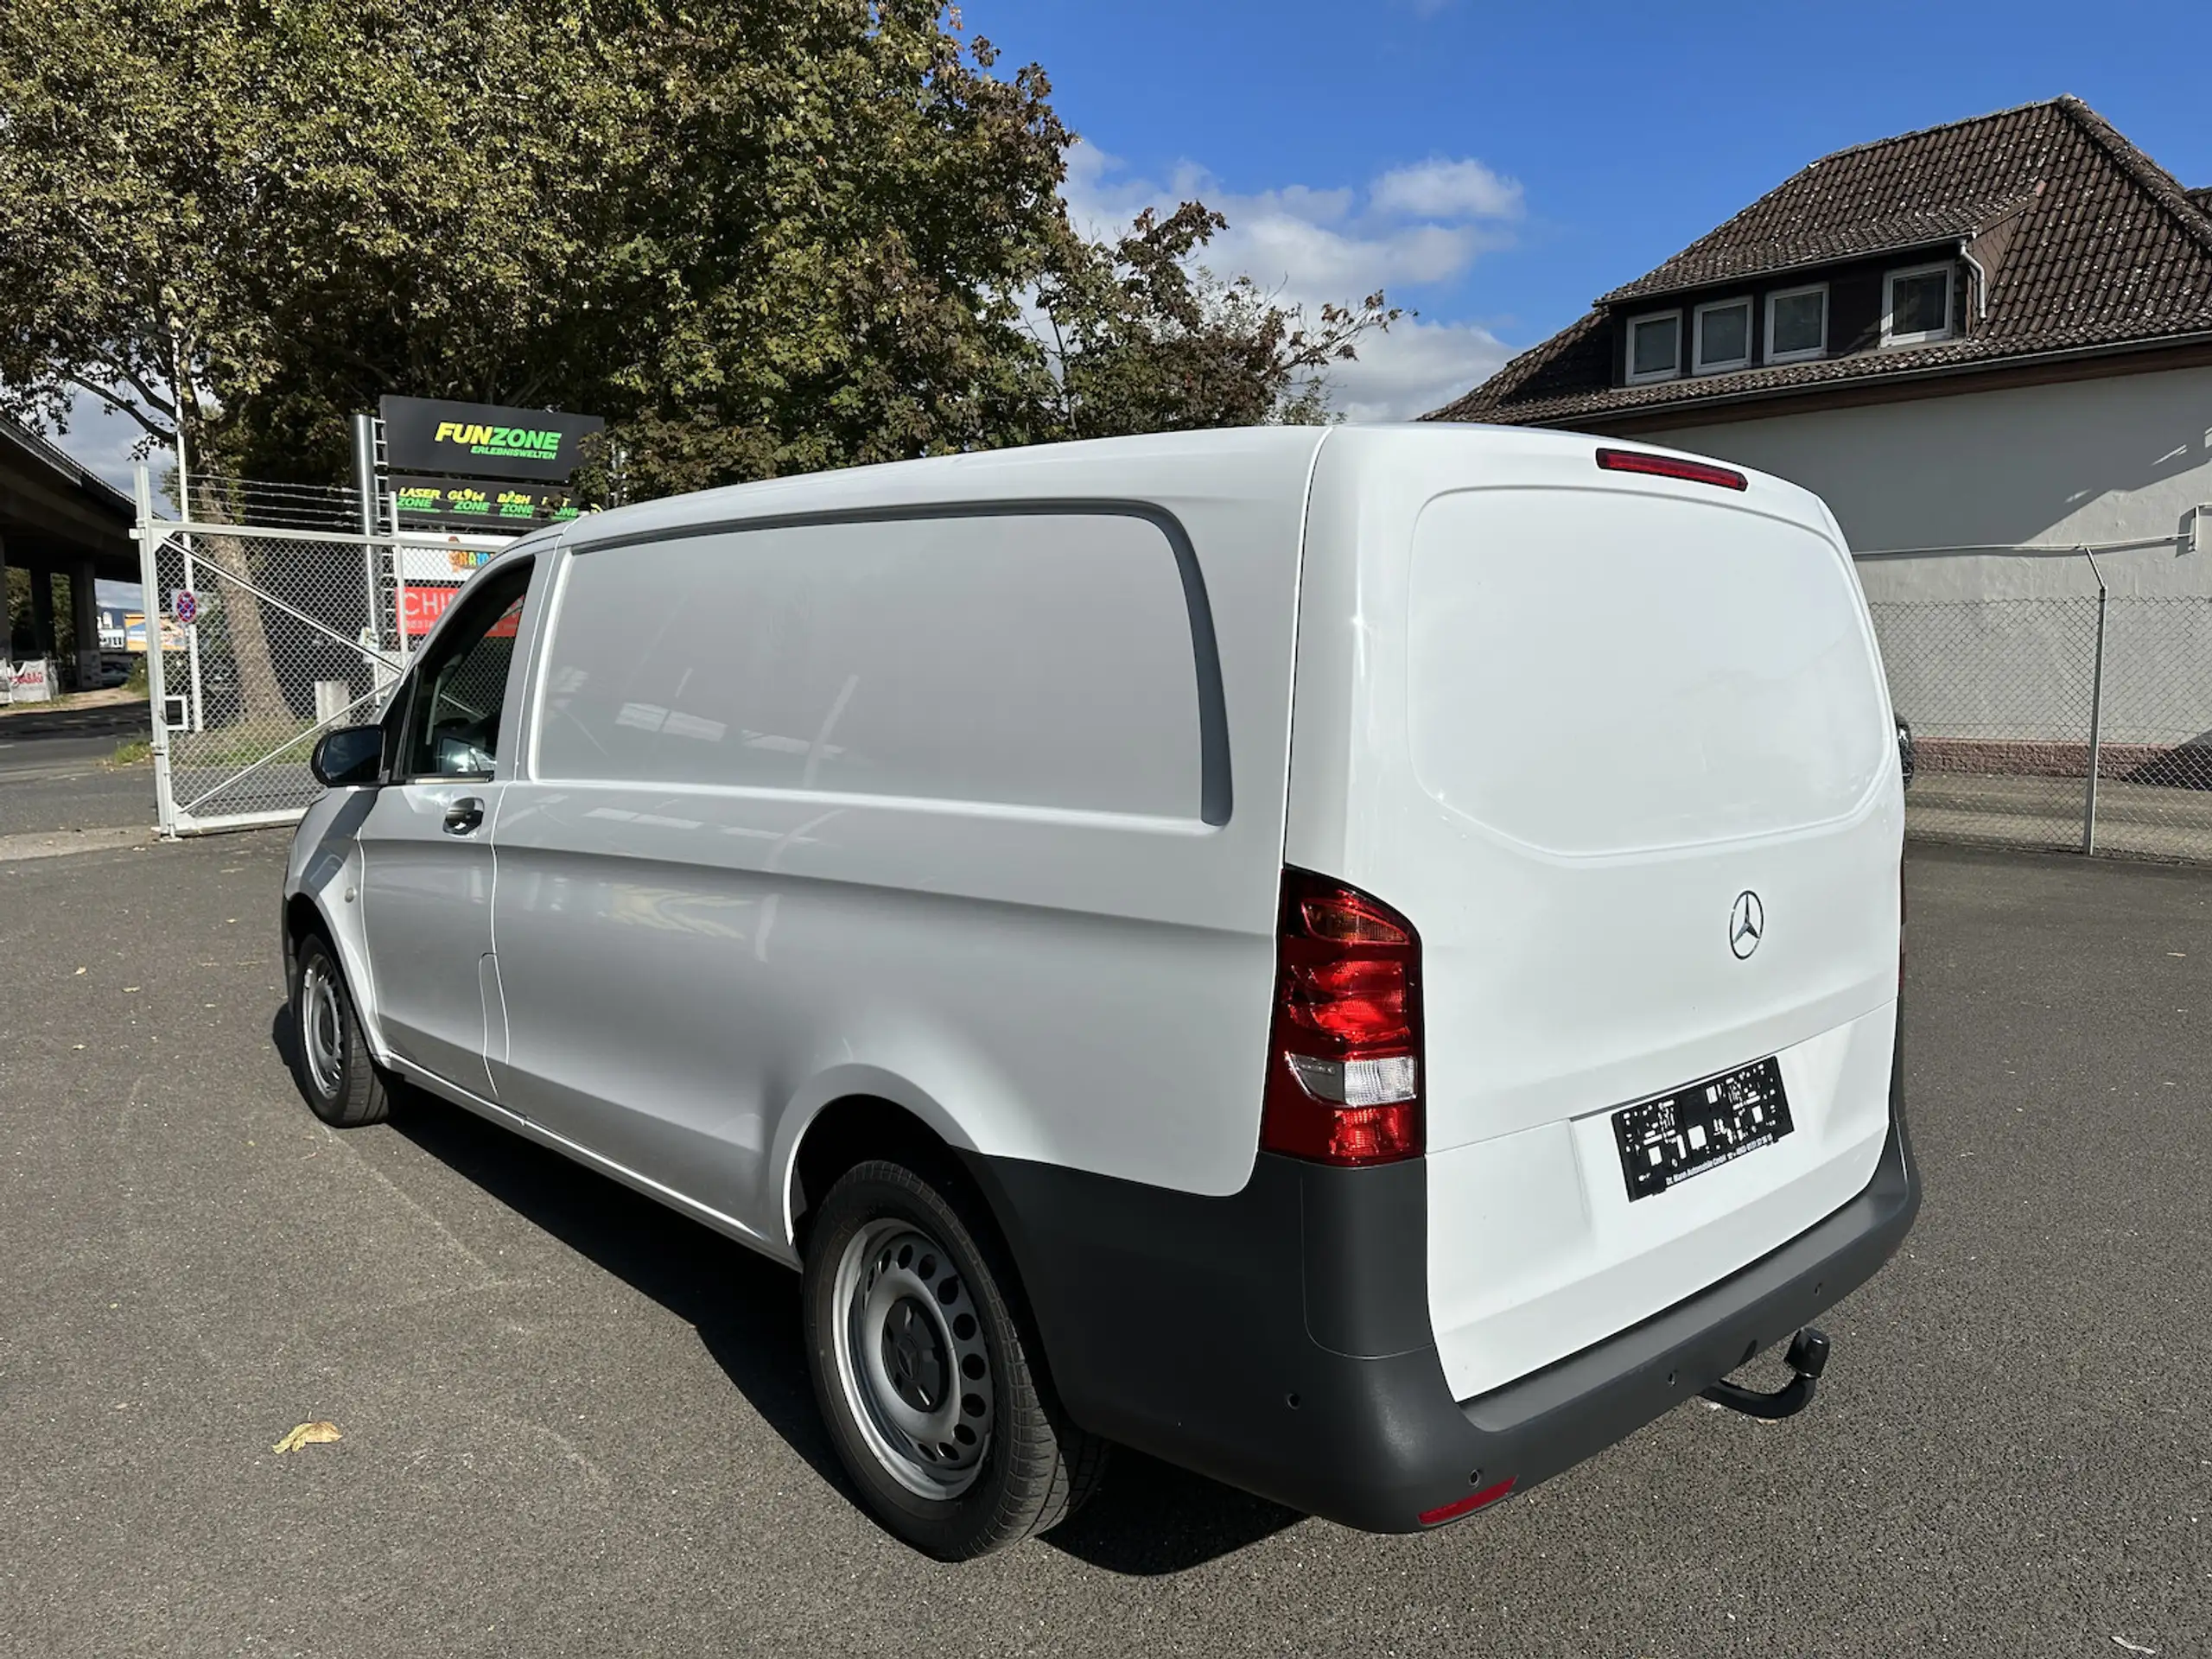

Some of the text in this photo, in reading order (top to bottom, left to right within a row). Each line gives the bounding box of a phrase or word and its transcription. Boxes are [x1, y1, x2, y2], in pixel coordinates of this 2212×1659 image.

[435, 422, 562, 450] FUNZONE
[470, 445, 556, 460] ERLEBNISWELTEN
[399, 486, 441, 499] LASER
[448, 488, 486, 501] GLOW
[397, 497, 432, 507] ZONE
[454, 501, 491, 512] ZONE
[500, 504, 535, 514] ZONE
